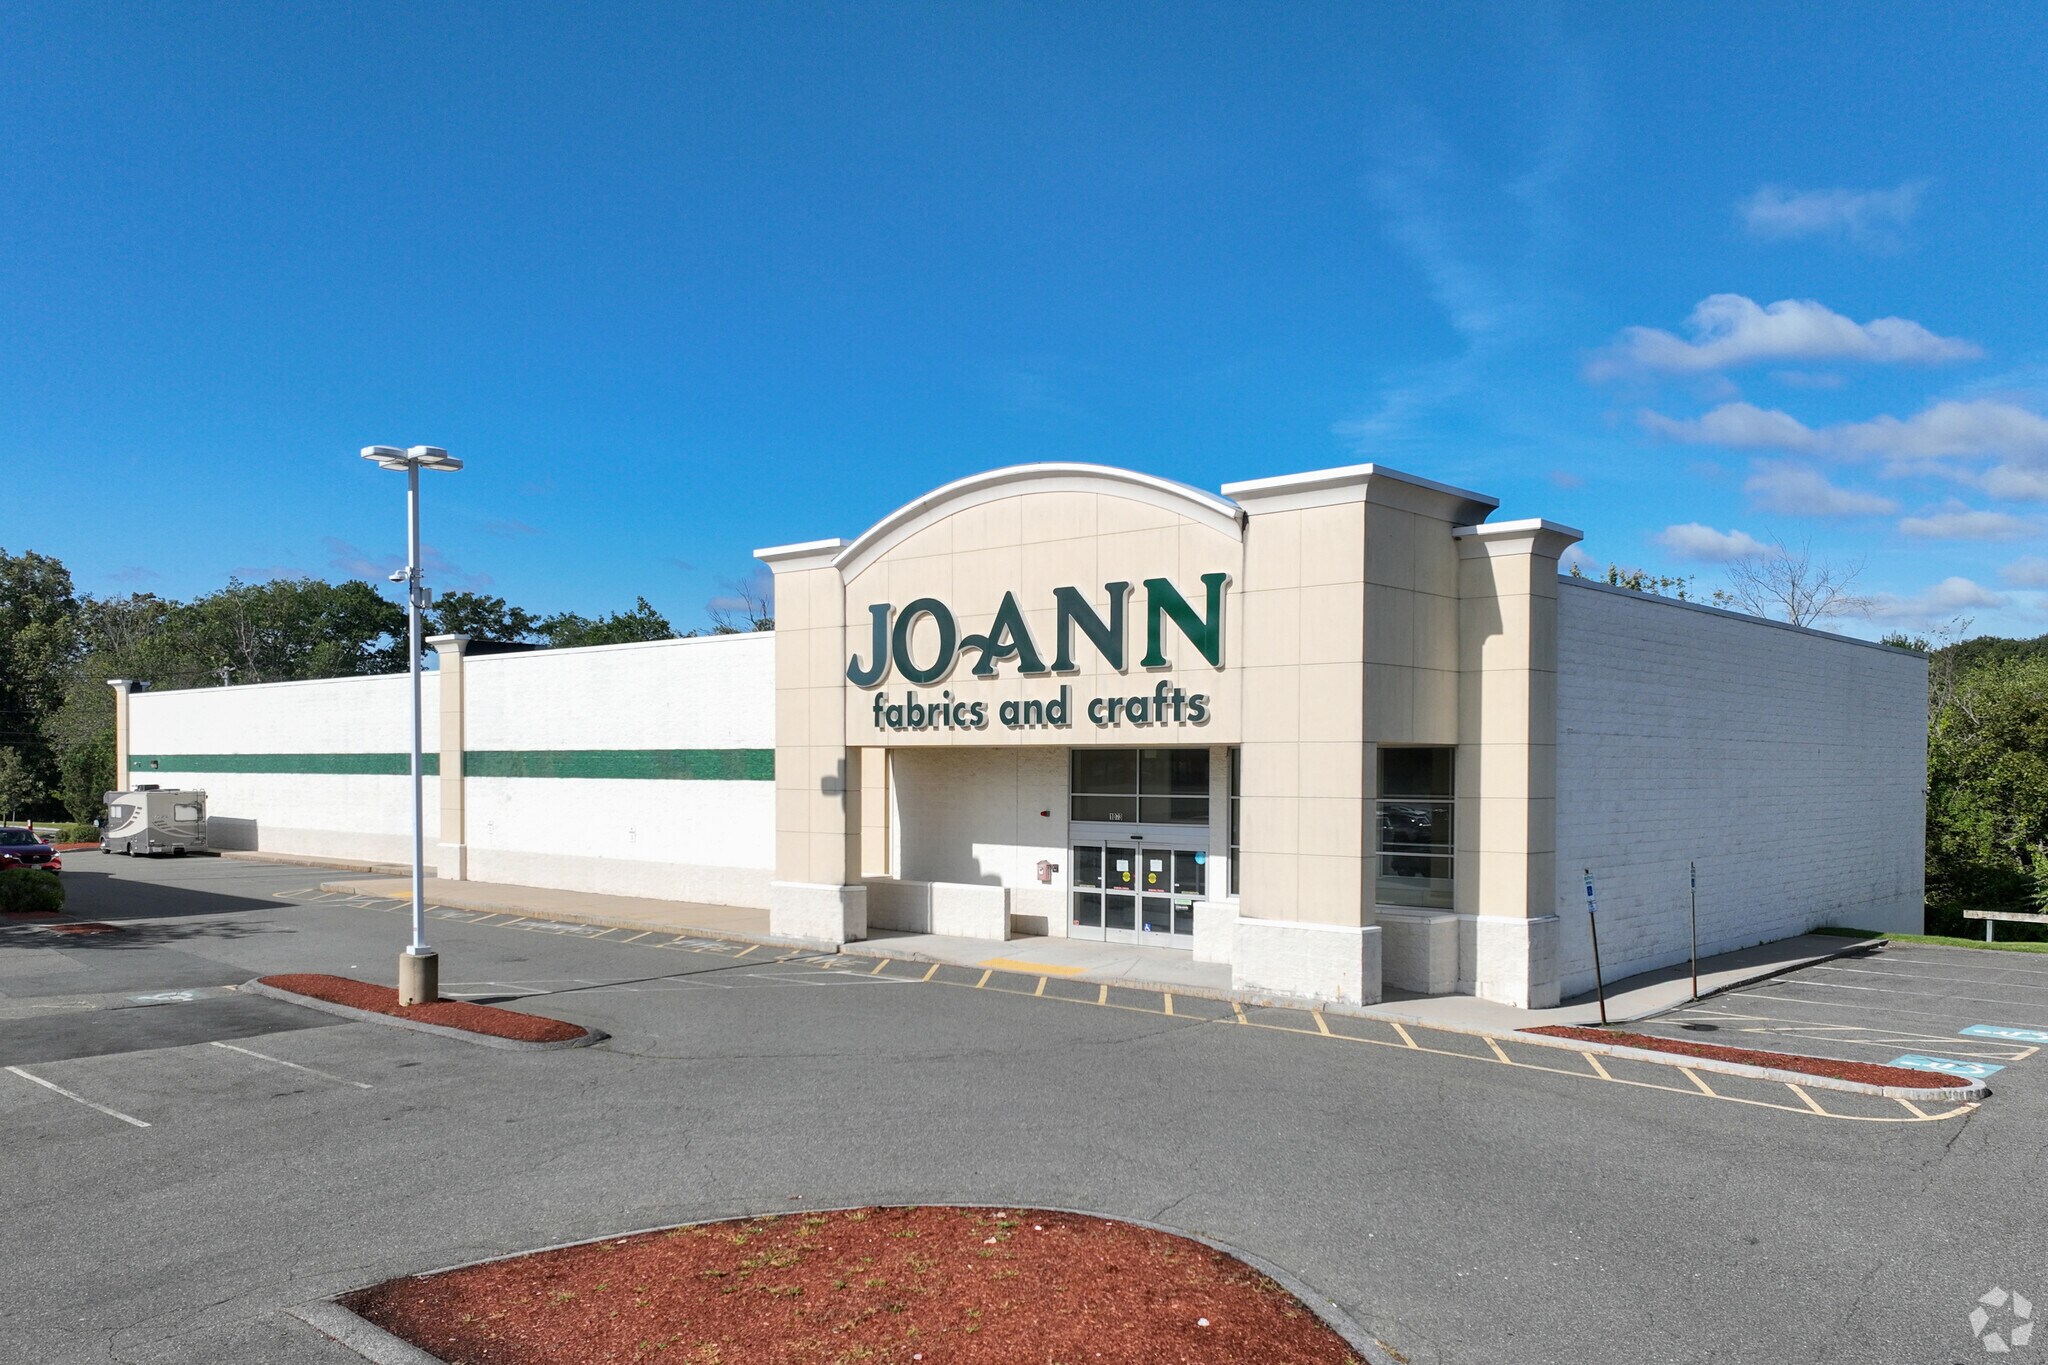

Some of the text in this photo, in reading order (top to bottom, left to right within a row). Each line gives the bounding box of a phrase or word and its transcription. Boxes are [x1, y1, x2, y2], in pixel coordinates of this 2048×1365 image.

[846, 572, 1232, 688] JOANN
[872, 679, 1211, 731] fabrics and crafts
